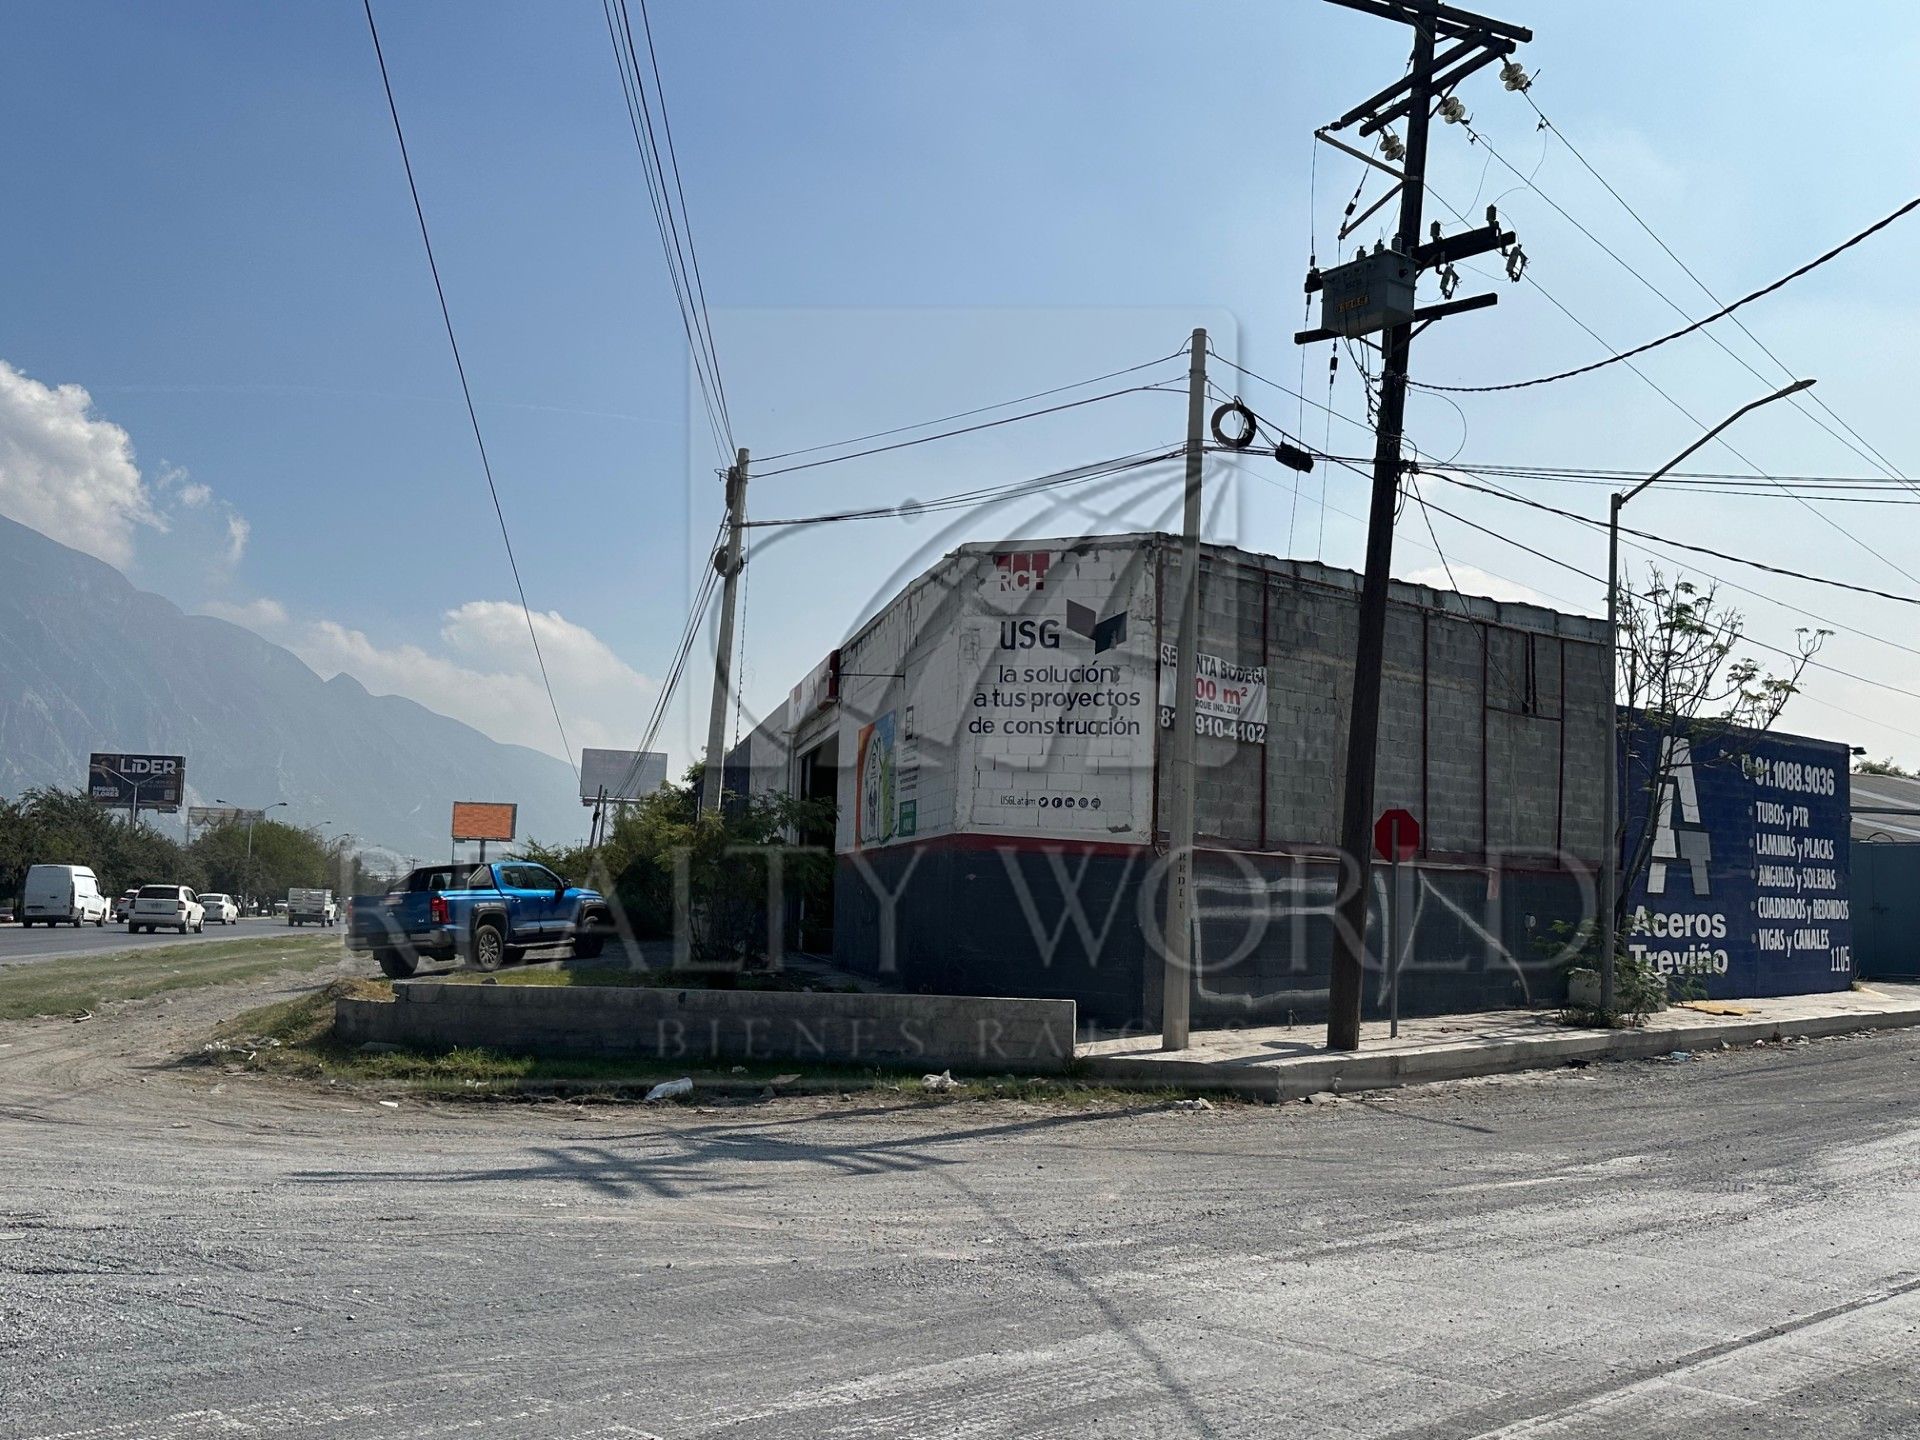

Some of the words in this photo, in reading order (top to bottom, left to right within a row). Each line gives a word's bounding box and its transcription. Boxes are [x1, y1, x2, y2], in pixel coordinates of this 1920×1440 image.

[998, 569, 1049, 592] RCH
[1000, 619, 1060, 650] USG
[1000, 665, 1020, 683] la
[1023, 661, 1115, 684] solución
[1162, 645, 1177, 668] SE
[1195, 654, 1217, 678] NTA
[1220, 658, 1266, 686] BODEGA
[974, 693, 987, 708] a
[992, 690, 1027, 708] tus
[1030, 690, 1141, 714] proyectos
[1195, 699, 1212, 711] RQUE
[969, 717, 996, 736] de
[1003, 717, 1141, 737] construcción
[1160, 707, 1176, 728] 8
[1196, 714, 1266, 744] 910-4102
[1756, 801, 1785, 826] TUBOS
[1786, 809, 1792, 829] y
[1793, 805, 1809, 829] PTR
[1756, 833, 1796, 858] LAMINAS
[1797, 843, 1803, 863] y
[1804, 839, 1834, 860] PLACAS
[1757, 866, 1795, 889] ANGULOS
[1796, 874, 1802, 893] y
[1803, 868, 1836, 890] SOLERAS
[1630, 905, 1727, 939] Aceros
[1757, 896, 1806, 920] CUADRADOS
[1806, 906, 1812, 924] y
[1813, 899, 1850, 920] REDONDOS
[1759, 928, 1785, 951] VIGAS
[1786, 936, 1793, 957] y
[1794, 929, 1829, 950] CANALES
[1628, 943, 1729, 975] Treviño
[1830, 945, 1850, 973] 1105
